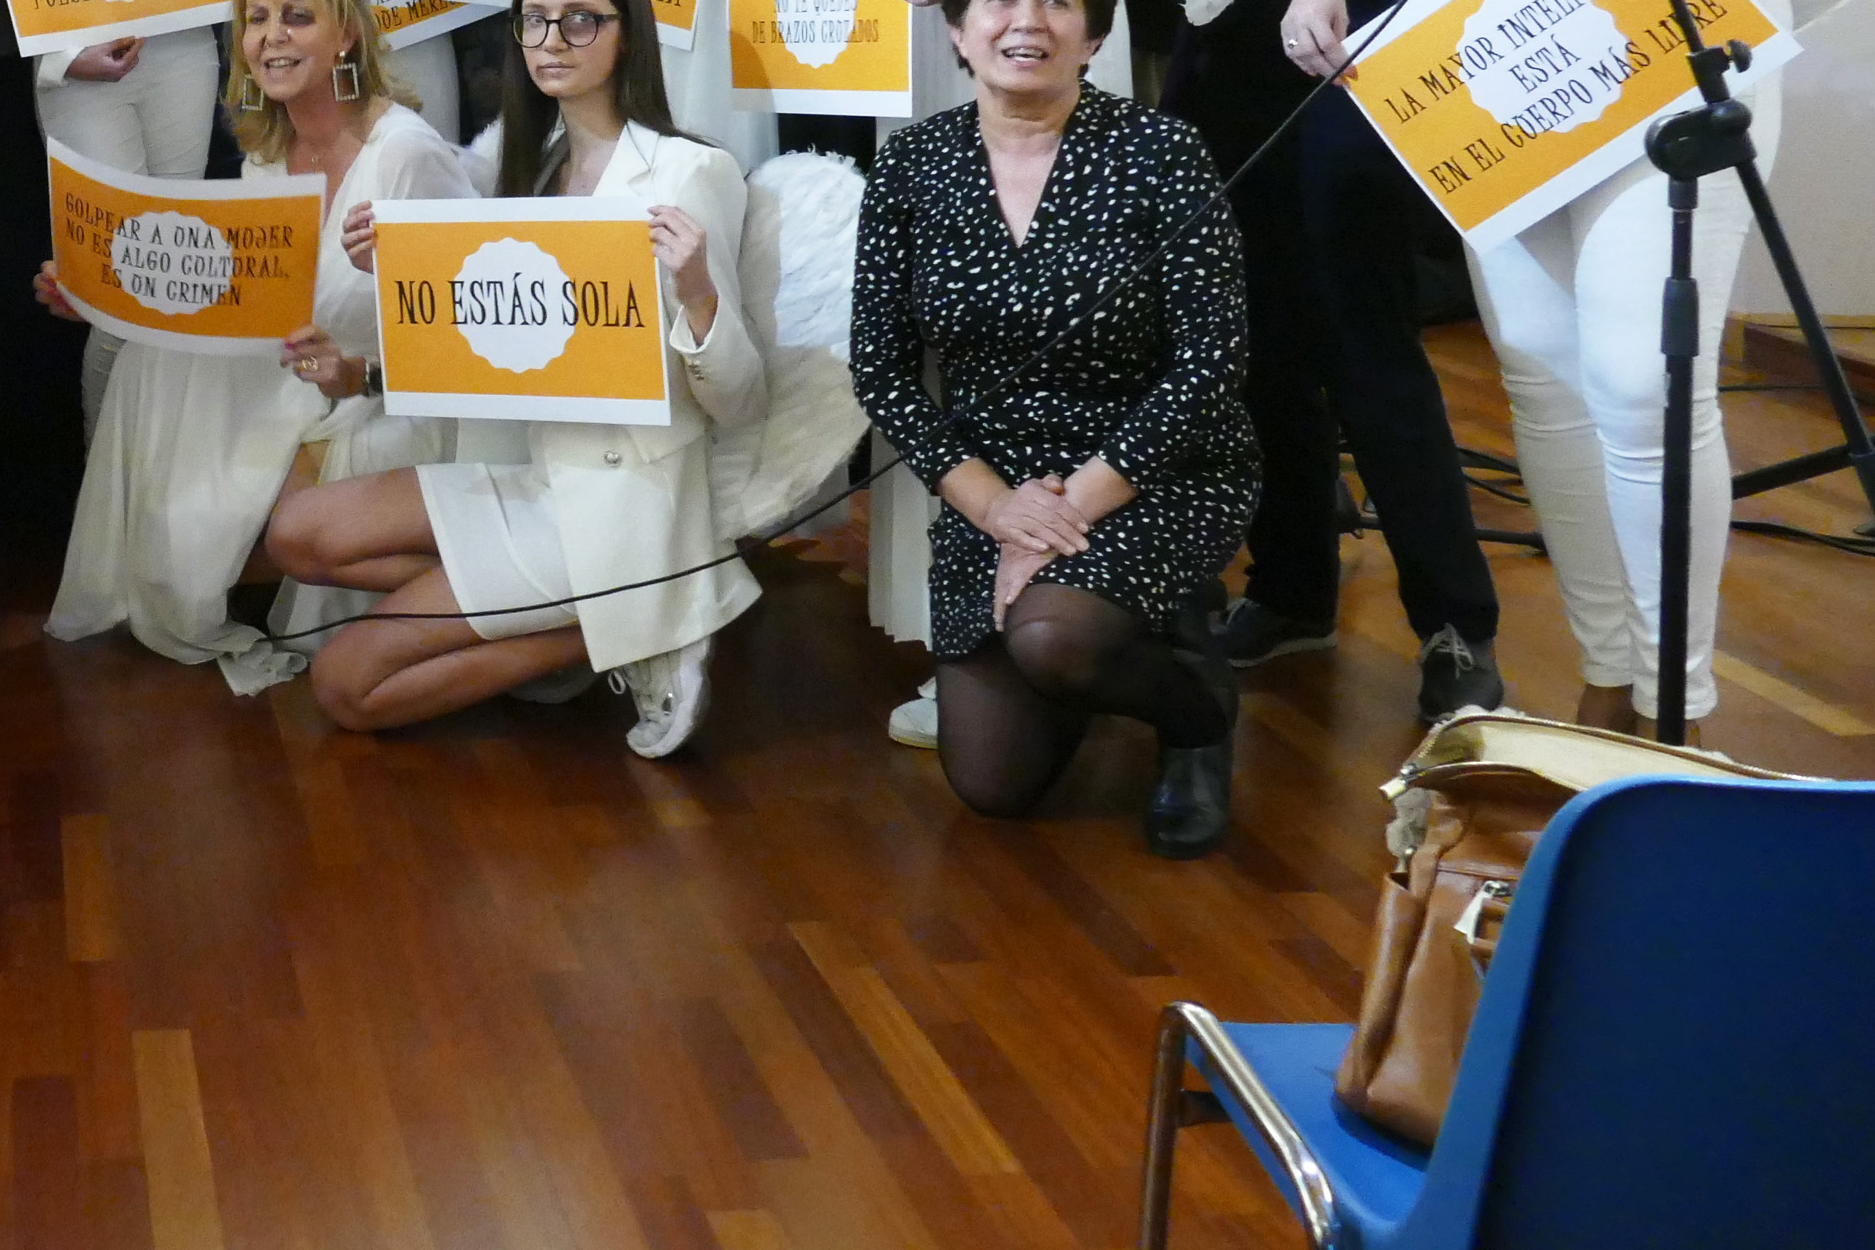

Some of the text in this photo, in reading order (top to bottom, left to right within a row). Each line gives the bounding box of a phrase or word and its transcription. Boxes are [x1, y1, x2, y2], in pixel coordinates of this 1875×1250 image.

[752, 18, 879, 44] DE BRAZOS CRUZADOS
[1383, 86, 1427, 125] LA
[1418, 35, 1504, 102] MAYOR
[1508, 33, 1581, 94] ESTÁ
[1428, 155, 1472, 194] EN
[1463, 138, 1506, 173] EL
[1500, 78, 1594, 149] CUERPO
[1588, 39, 1651, 92] MÁS
[65, 192, 293, 250] GOLPEAR A UNA MUJER
[66, 217, 85, 246] NO
[93, 233, 113, 259] ES
[121, 246, 171, 274] ALGO
[101, 263, 242, 307] ES UN CRIMEN
[394, 272, 646, 328] NO ESTÁS SOLA
